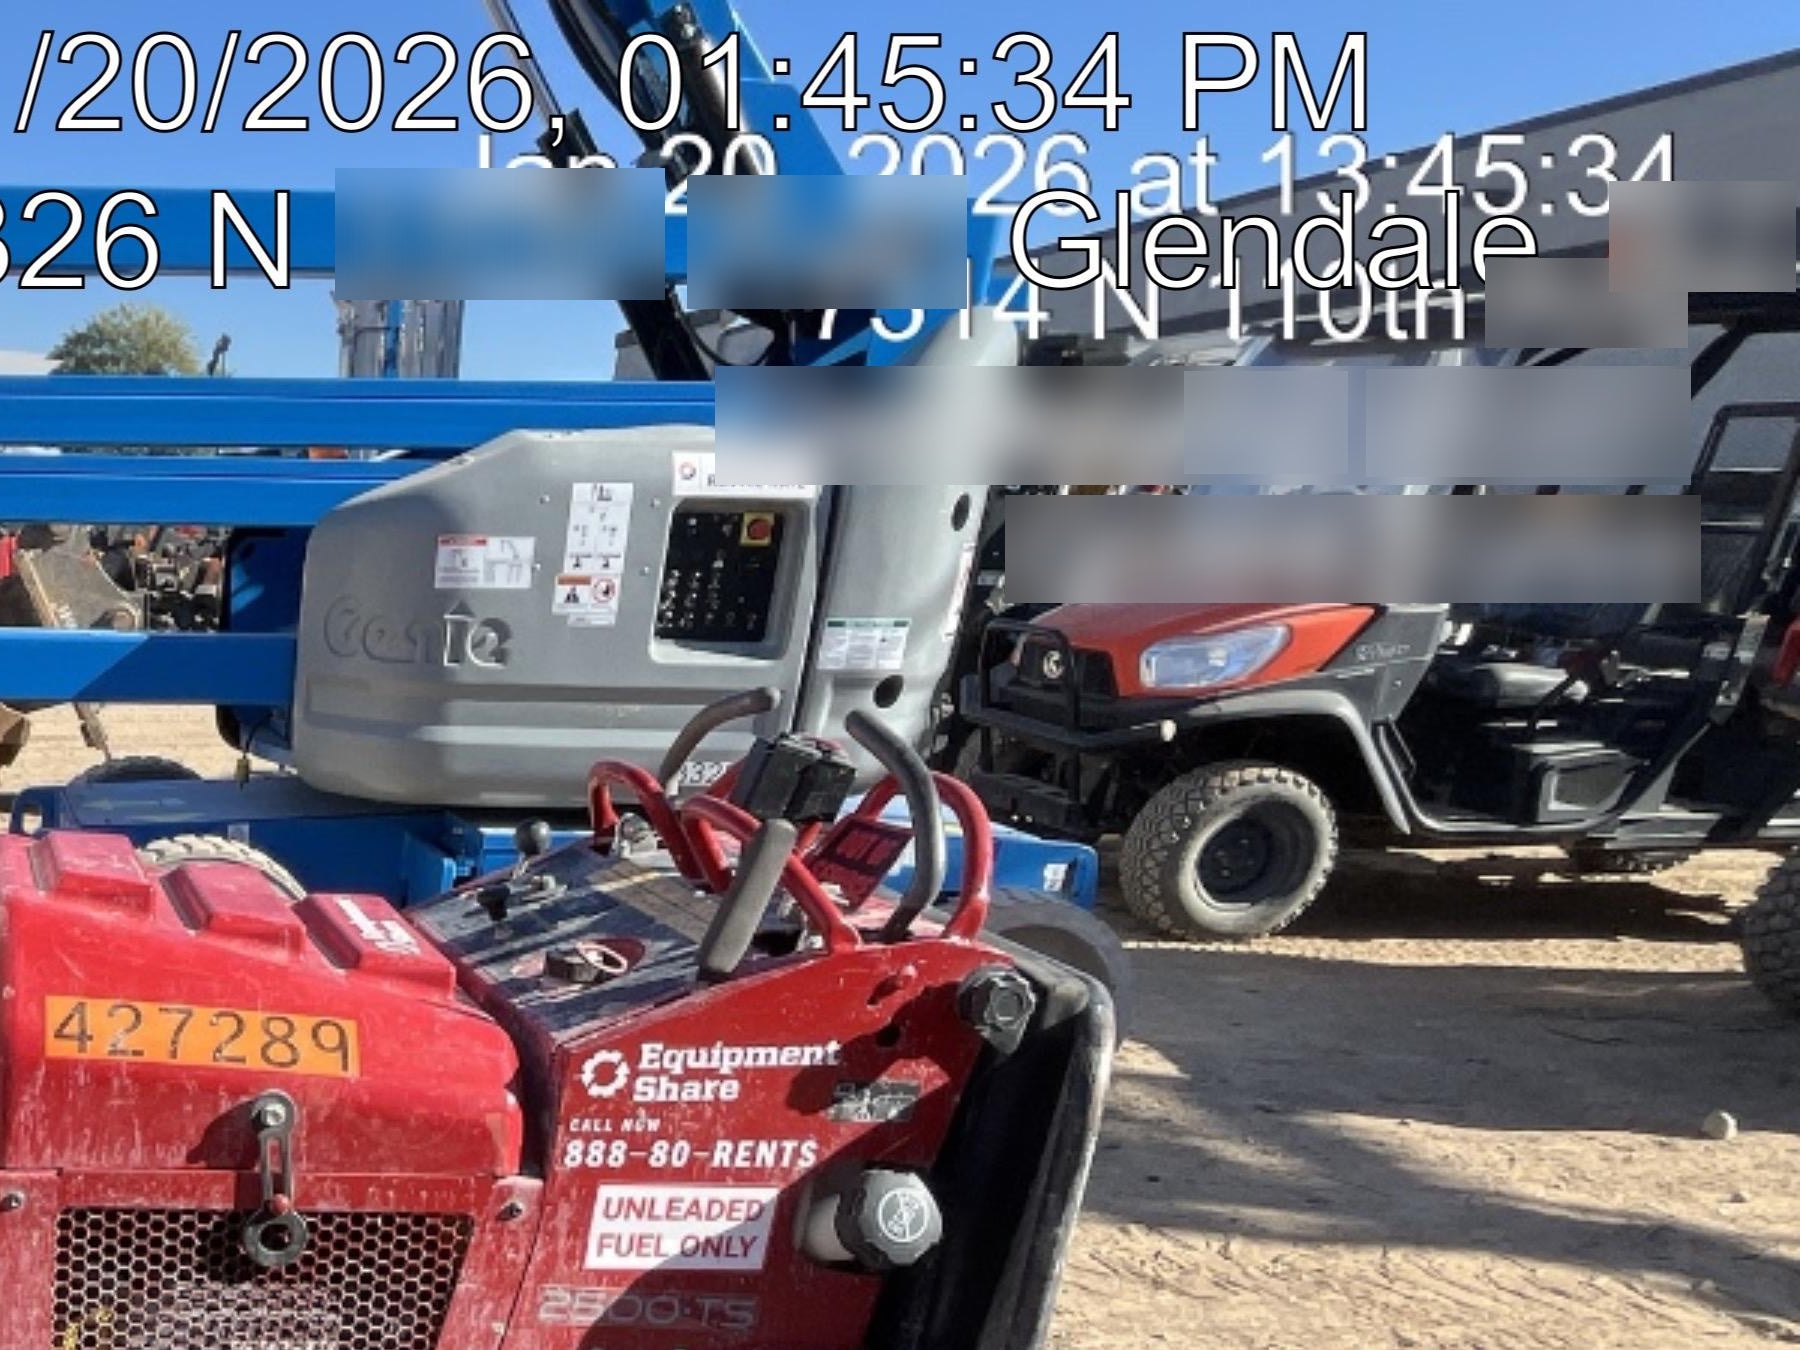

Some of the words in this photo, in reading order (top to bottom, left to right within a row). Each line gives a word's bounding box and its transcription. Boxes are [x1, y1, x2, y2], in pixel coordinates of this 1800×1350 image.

[52, 1001, 351, 1072] 427289
[637, 1040, 842, 1075] Equipment
[631, 1075, 741, 1101] Share
[569, 1117, 614, 1133] CALL
[620, 1116, 662, 1133] NOW
[563, 1138, 820, 1169] 888-80-RENTS
[601, 1196, 766, 1222] UNLEADED
[595, 1232, 671, 1259] FUEL
[678, 1233, 761, 1259] ONLY
